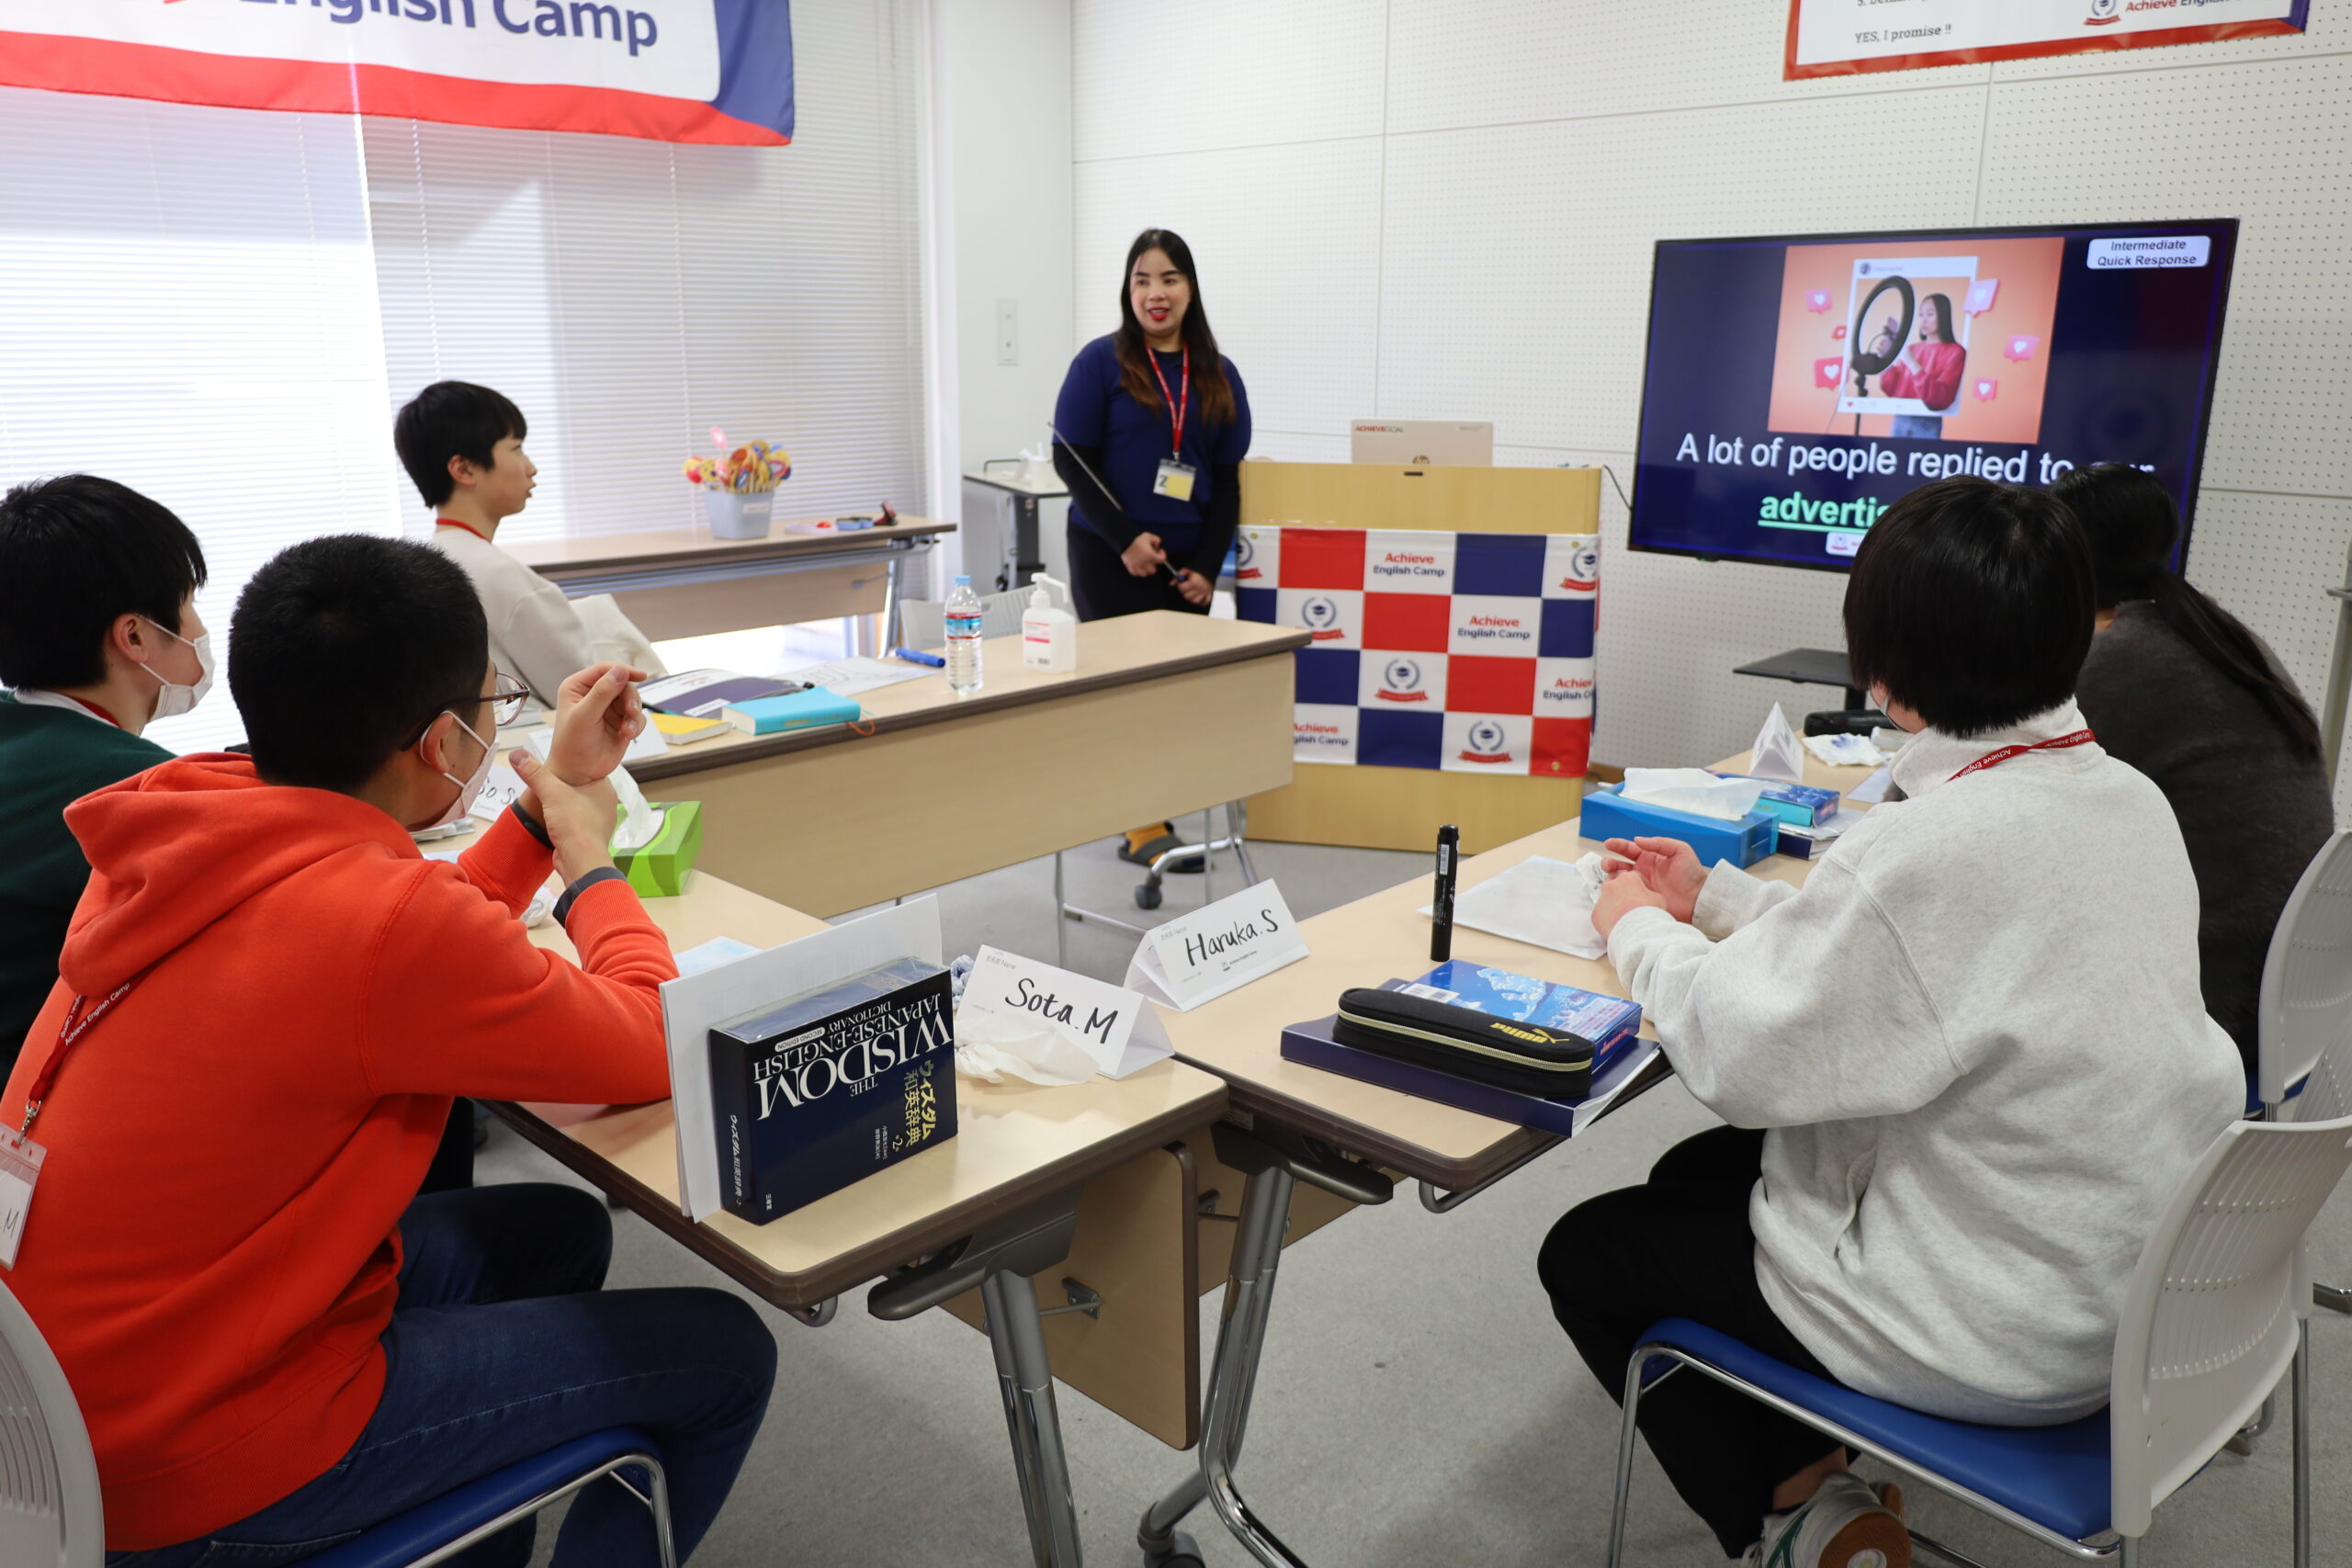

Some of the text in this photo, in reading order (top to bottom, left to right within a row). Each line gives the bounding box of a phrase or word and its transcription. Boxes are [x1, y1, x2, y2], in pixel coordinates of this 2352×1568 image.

[2125, 0, 2177, 12] Achieve
[493, 0, 658, 57] Camp
[1855, 31, 1880, 43] YES,
[1883, 29, 1888, 40] I
[1891, 25, 1941, 42] promise
[2110, 240, 2187, 251] Intermediate
[2097, 255, 2197, 267] Quick Response
[1676, 433, 1699, 463] A
[1707, 433, 1745, 466] lot
[1750, 436, 1784, 468] of
[1788, 442, 1897, 480] people
[1907, 446, 2029, 484] replied
[1385, 552, 1434, 564] Achieve
[1373, 565, 1445, 578] English Camp
[1469, 615, 1520, 626] Achieve
[1457, 627, 1531, 640] English Camp
[1543, 690, 1582, 701] English
[1318, 736, 1349, 747] Camp
[1983, 749, 2011, 764] Achieve
[65, 983, 130, 1046] Achieve English Camp
[827, 1001, 892, 1035] DICTIONARY
[753, 993, 941, 1081] JAPANESE-ENGLISH
[777, 1029, 823, 1050] SECOND EDITION
[754, 1010, 954, 1121] WISDOM
[850, 1077, 878, 1097] THE
[904, 1067, 921, 1148] 和英辞典
[919, 1059, 937, 1140] ウィズダム
